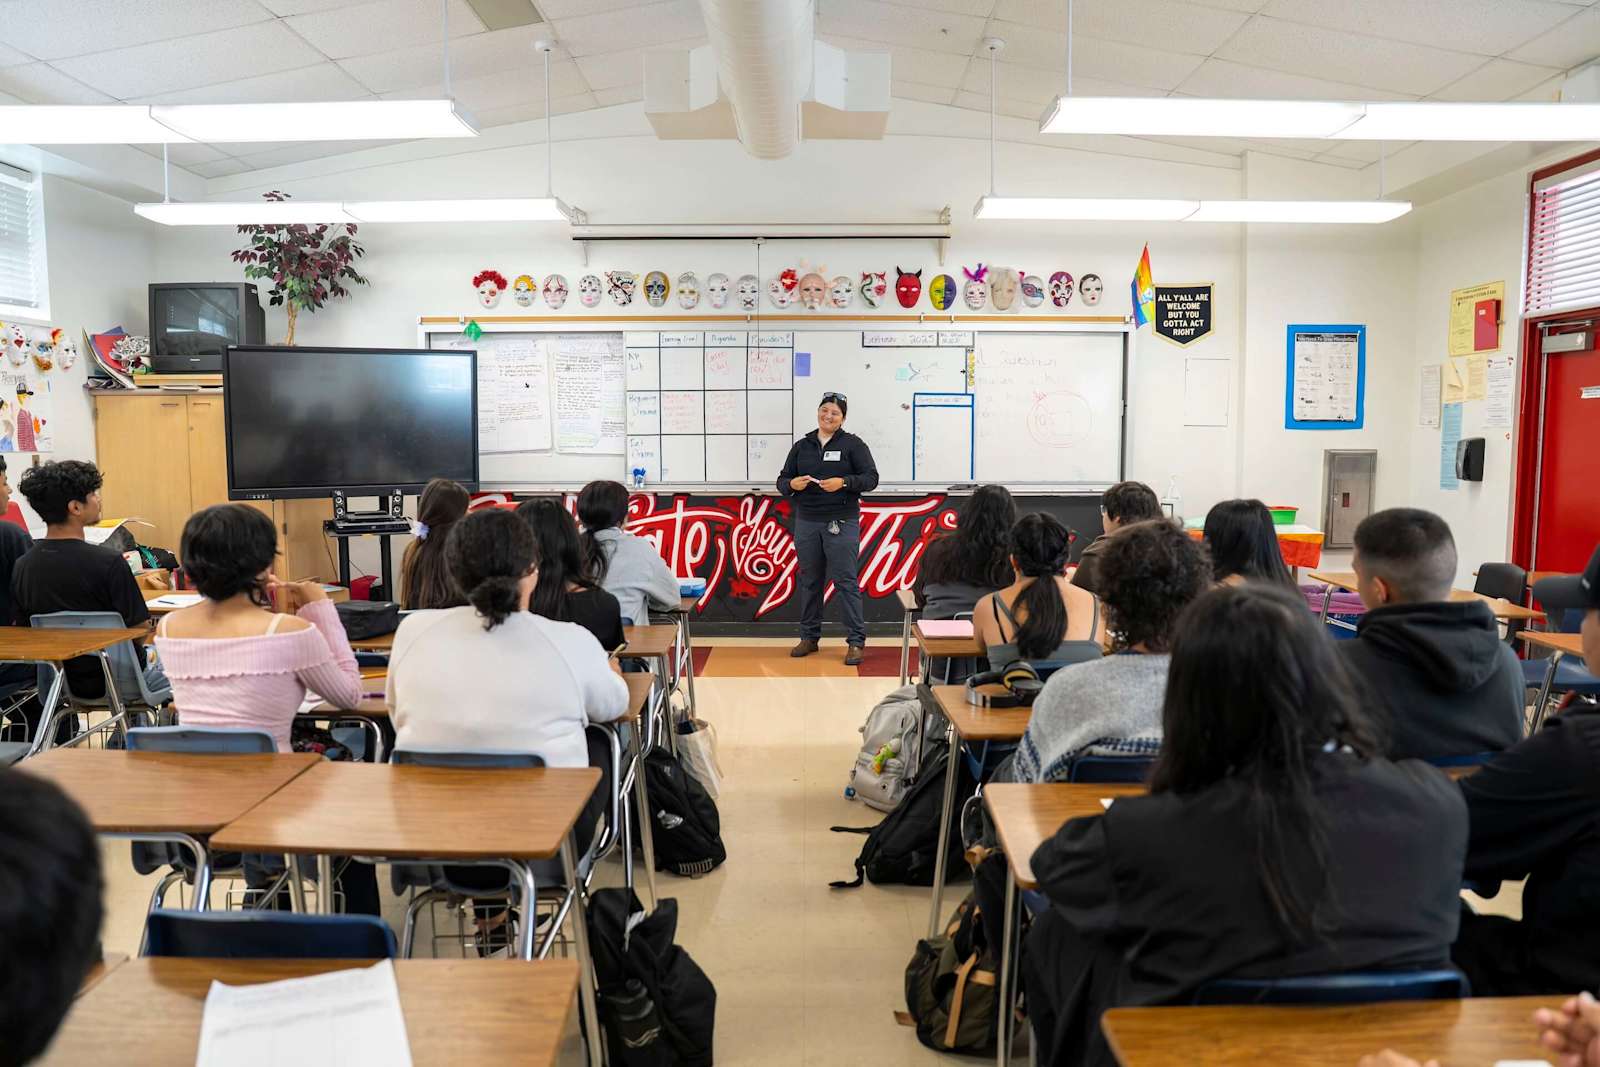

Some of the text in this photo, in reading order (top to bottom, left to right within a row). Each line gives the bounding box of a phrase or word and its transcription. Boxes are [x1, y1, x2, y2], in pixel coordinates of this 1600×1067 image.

[1195, 293, 1209, 301] ARE
[1166, 302, 1201, 310] WELCOME
[1168, 311, 1183, 319] BUT
[1190, 319, 1204, 327] ACT
[1172, 328, 1195, 336] RIGHT
